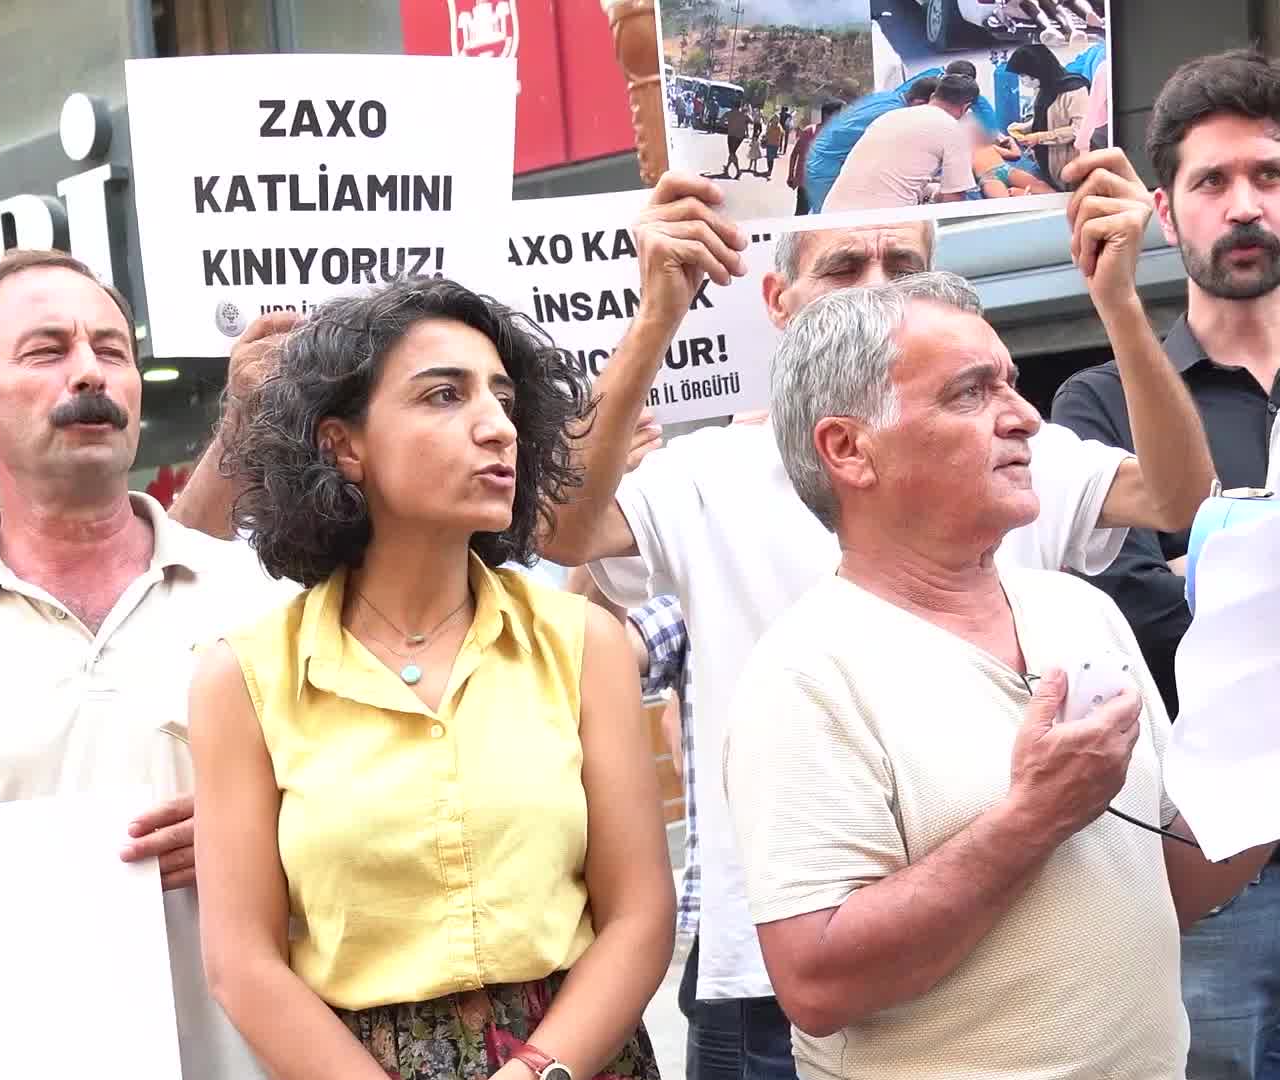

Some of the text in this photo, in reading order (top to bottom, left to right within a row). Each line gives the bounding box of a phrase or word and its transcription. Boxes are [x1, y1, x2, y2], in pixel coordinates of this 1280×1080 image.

[259, 99, 387, 138] ZAXO
[193, 163, 453, 213] KATLİAMINI
[202, 247, 445, 286] KINIYORUZ!
[664, 383, 678, 404] İL
[681, 372, 740, 401] ÖRGÜTÜ
